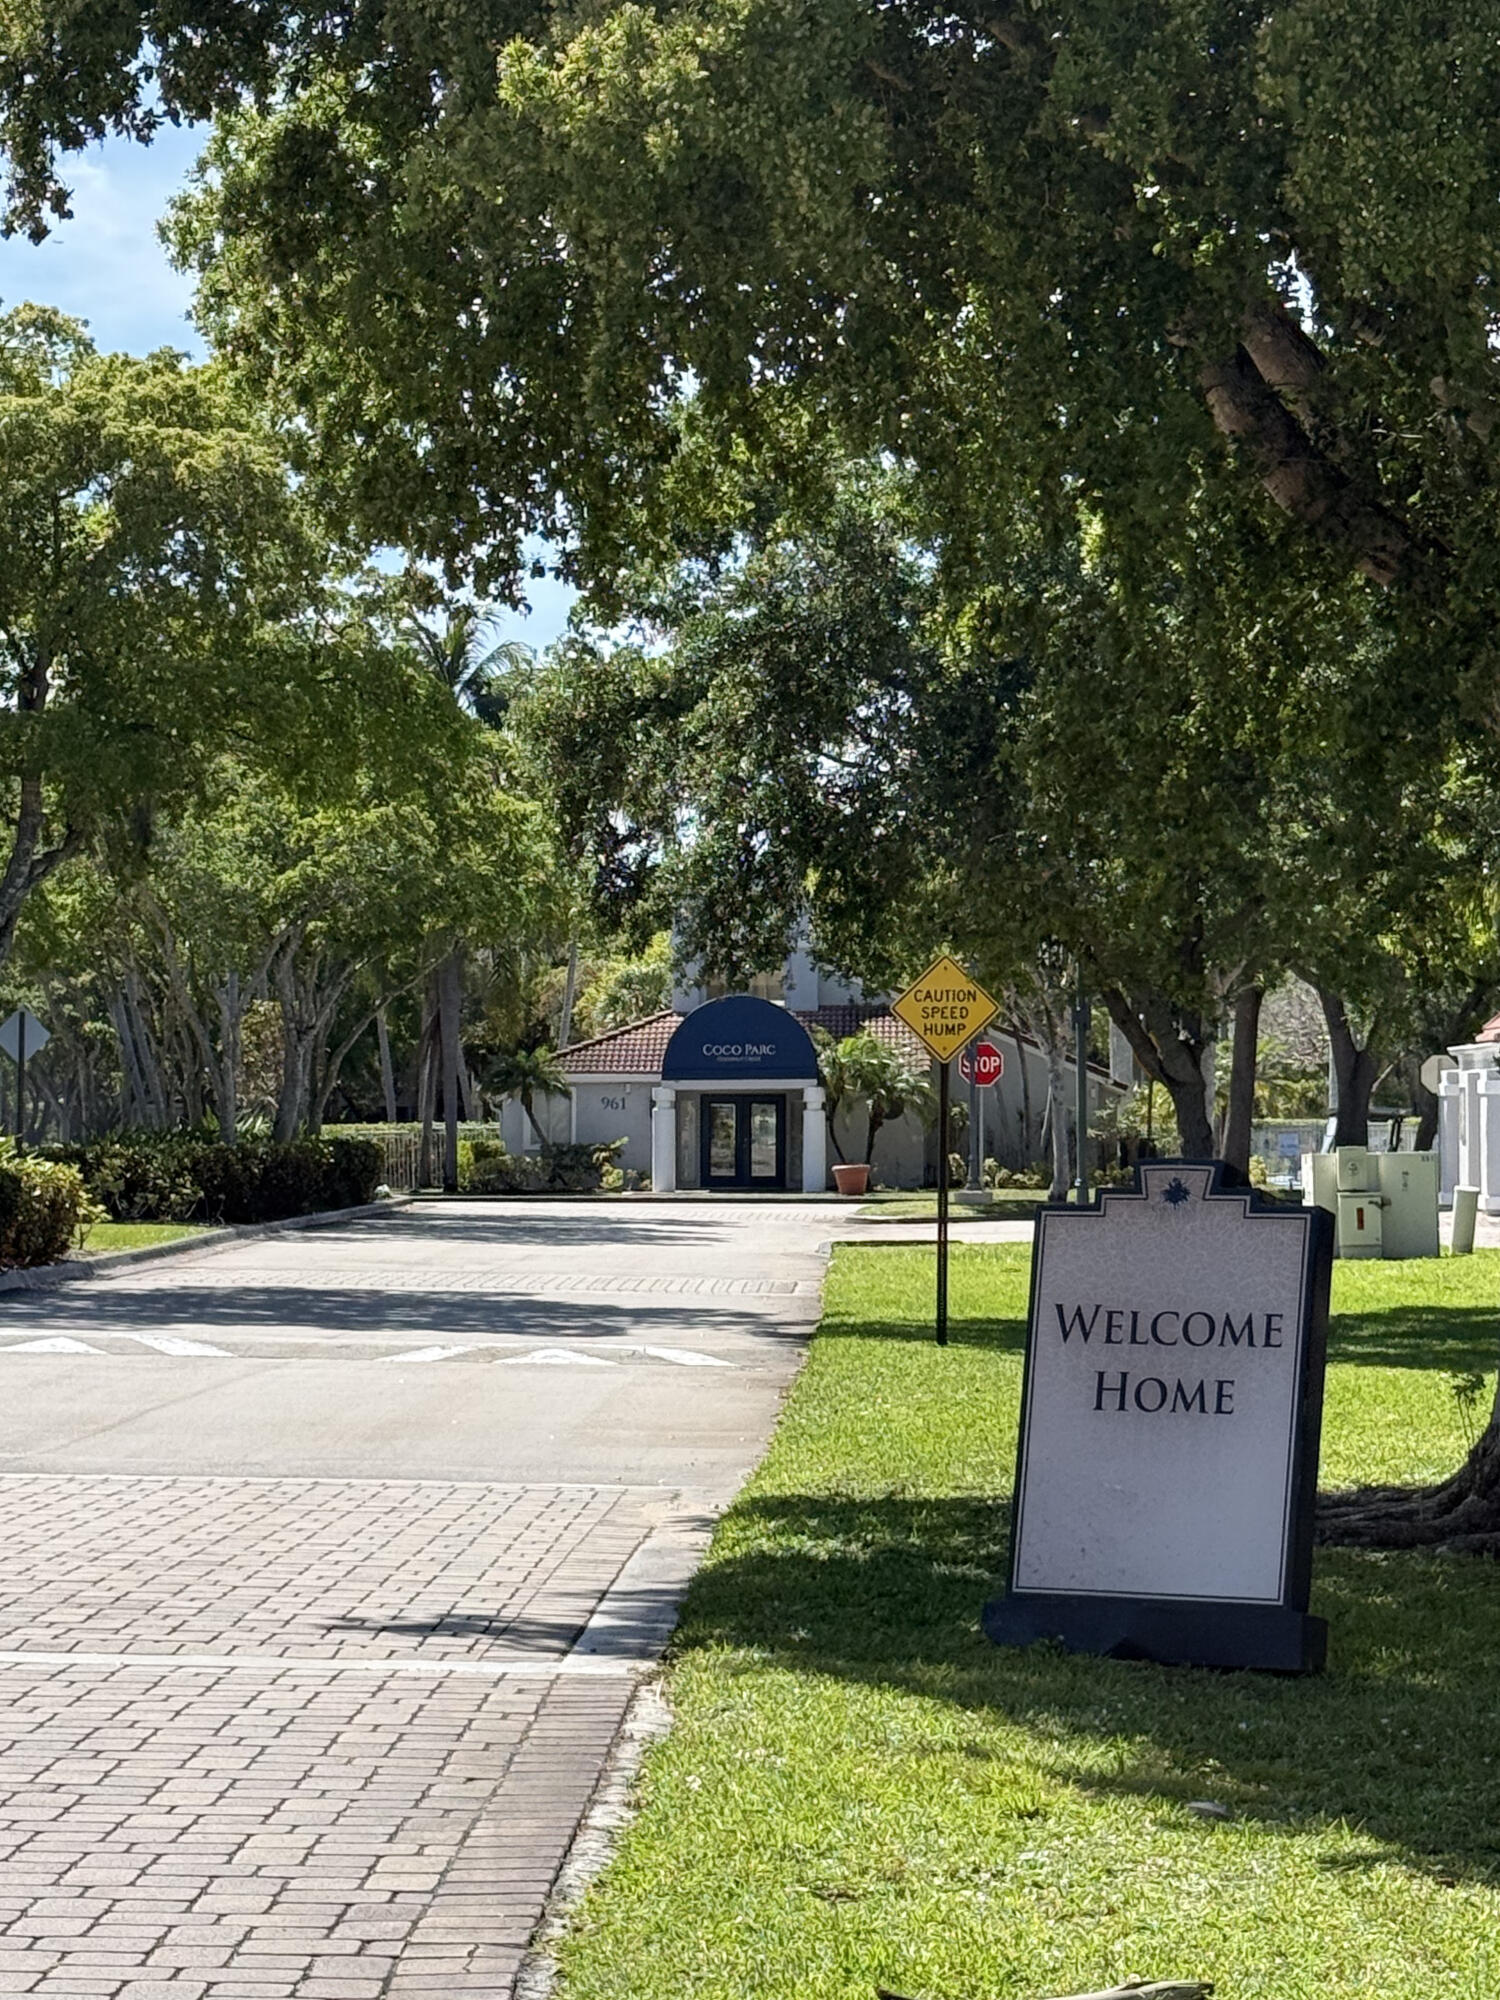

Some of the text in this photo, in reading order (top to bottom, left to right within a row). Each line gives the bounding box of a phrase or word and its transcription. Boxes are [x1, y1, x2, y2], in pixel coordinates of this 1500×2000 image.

[913, 989, 977, 1002] CAUTION
[921, 1006, 969, 1020] SPEED
[923, 1023, 967, 1036] HUMP
[600, 1096, 626, 1110] 961
